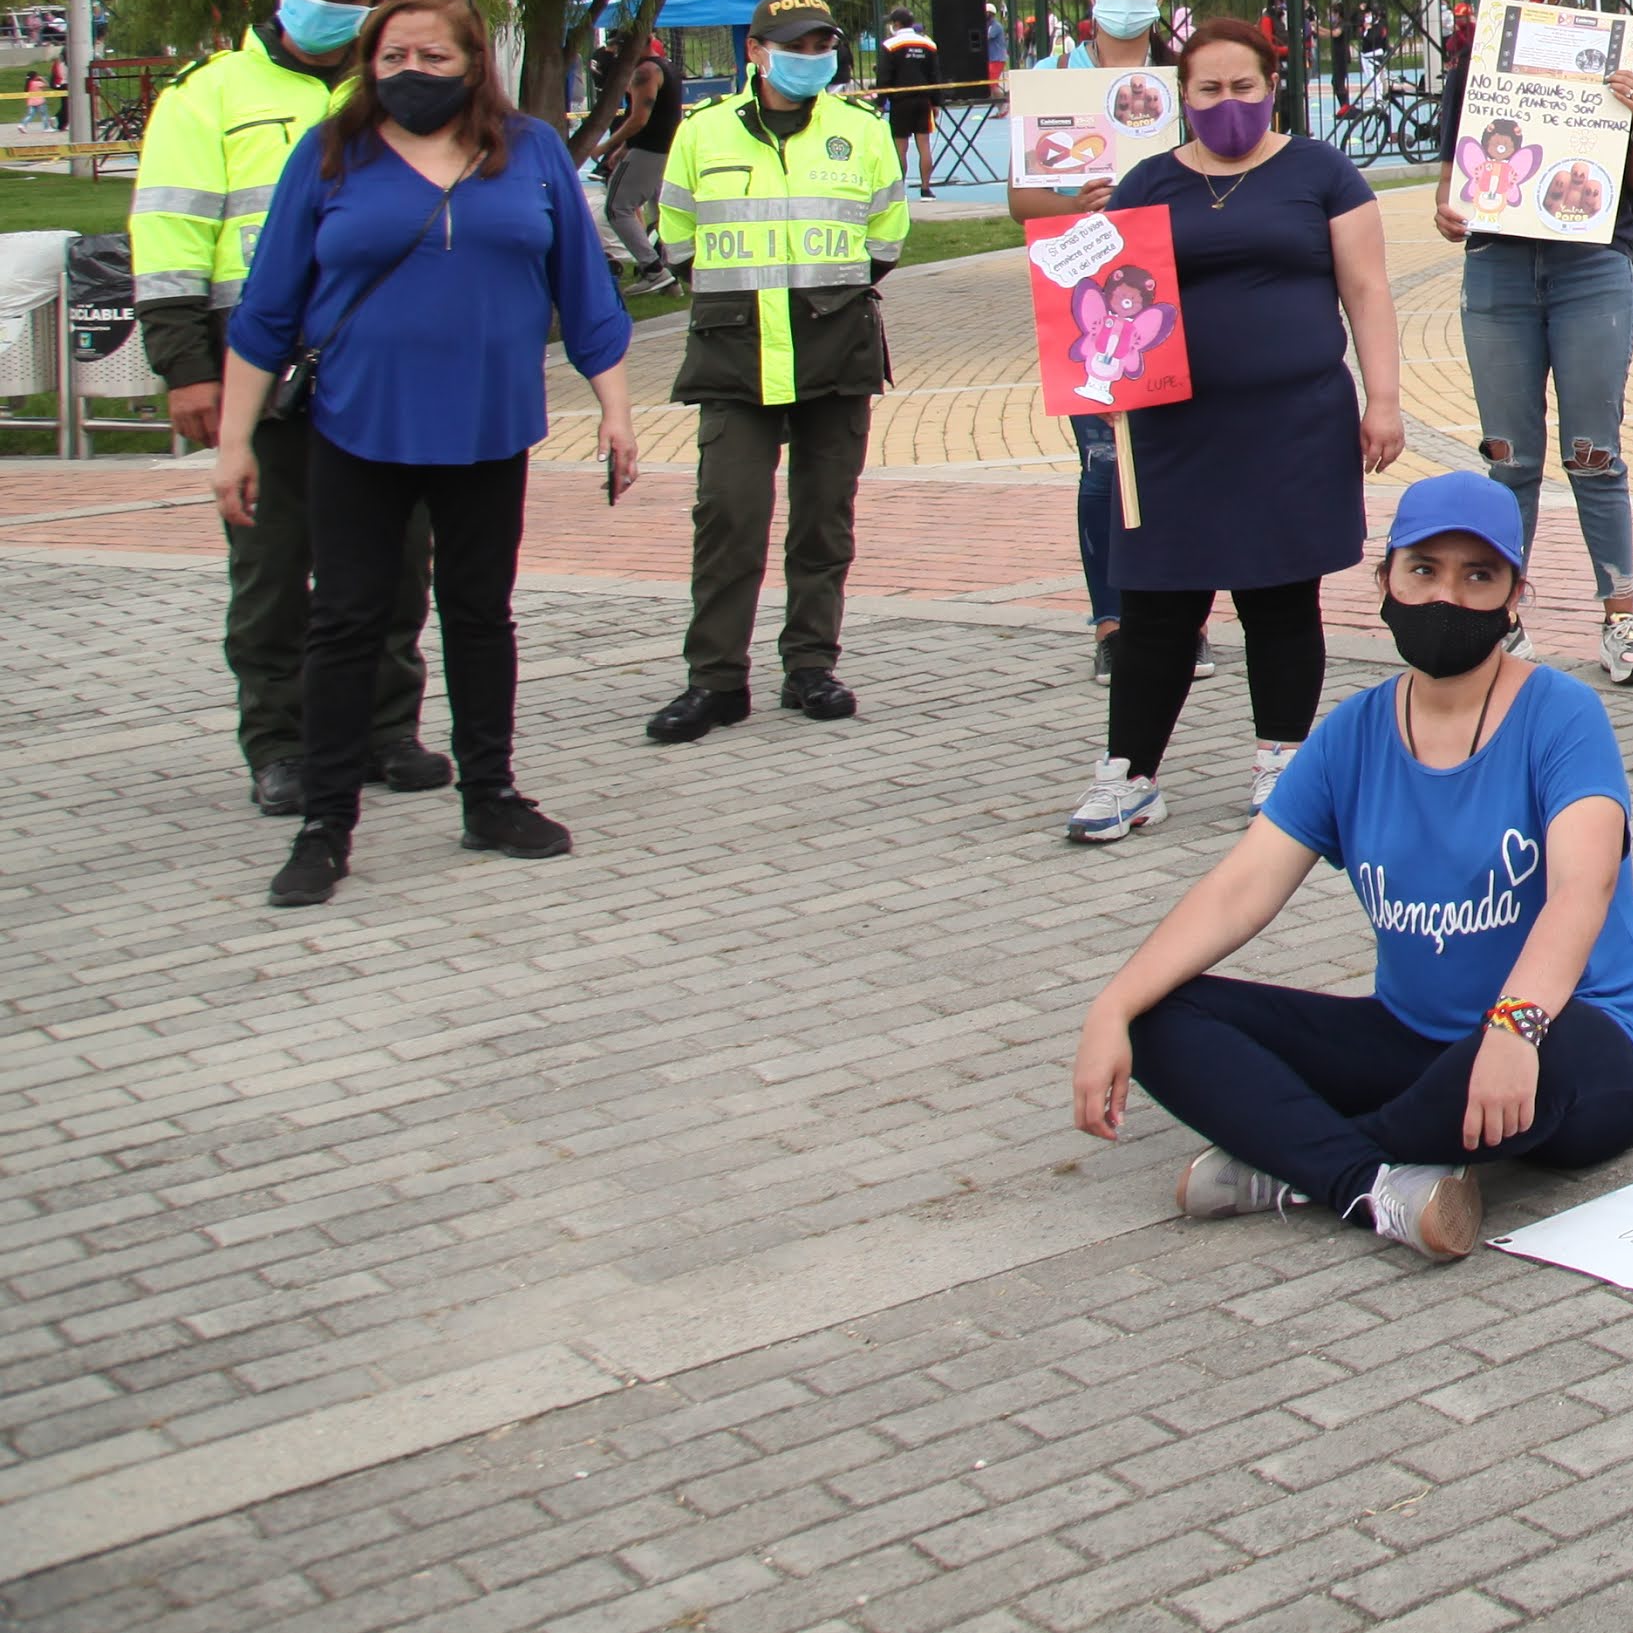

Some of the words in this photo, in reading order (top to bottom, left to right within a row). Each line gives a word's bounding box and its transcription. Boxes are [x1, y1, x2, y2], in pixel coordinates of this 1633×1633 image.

[1467, 89, 1511, 105] BUENOS
[1572, 104, 1596, 114] SON
[1470, 74, 1491, 88] NO
[1497, 76, 1512, 91] LO
[1581, 90, 1604, 105] LOS
[1468, 103, 1532, 122] DIFICILES
[1543, 113, 1559, 125] DE
[1563, 116, 1630, 132] ENCONTRAR
[1360, 862, 1521, 955] Abençoada
